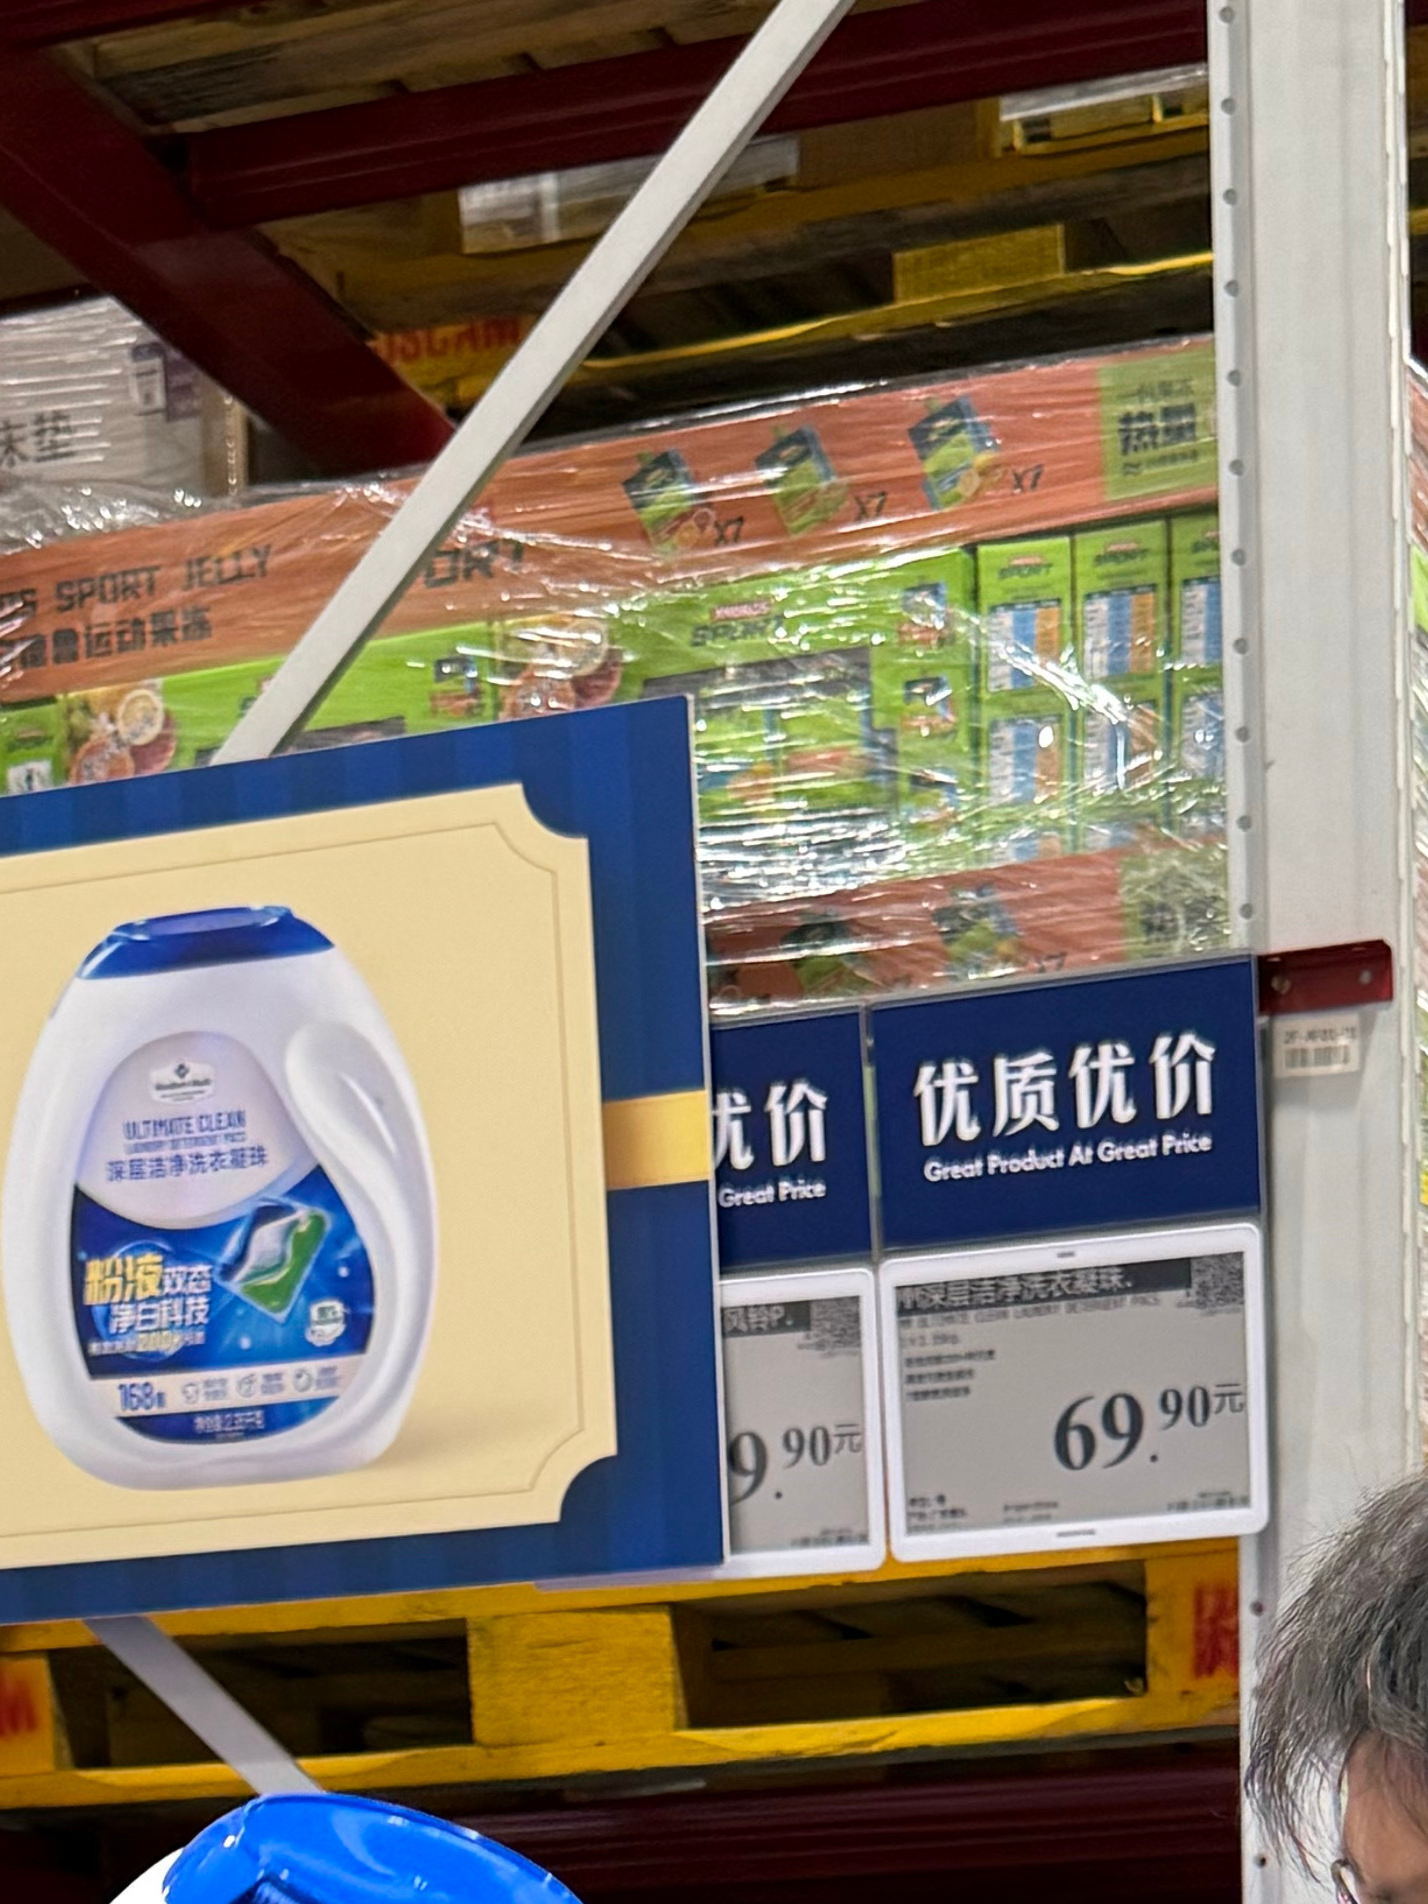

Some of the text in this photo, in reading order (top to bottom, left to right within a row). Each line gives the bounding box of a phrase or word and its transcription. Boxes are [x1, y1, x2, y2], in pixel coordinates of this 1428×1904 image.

[55, 565, 161, 613] SPORT
[183, 543, 272, 590] JELLY
[913, 1029, 1217, 1148] 优质优价
[924, 1131, 1213, 1183] Great Product At Great Price
[719, 1178, 826, 1208] Great Price
[1053, 1380, 1246, 1473] 69.90元
